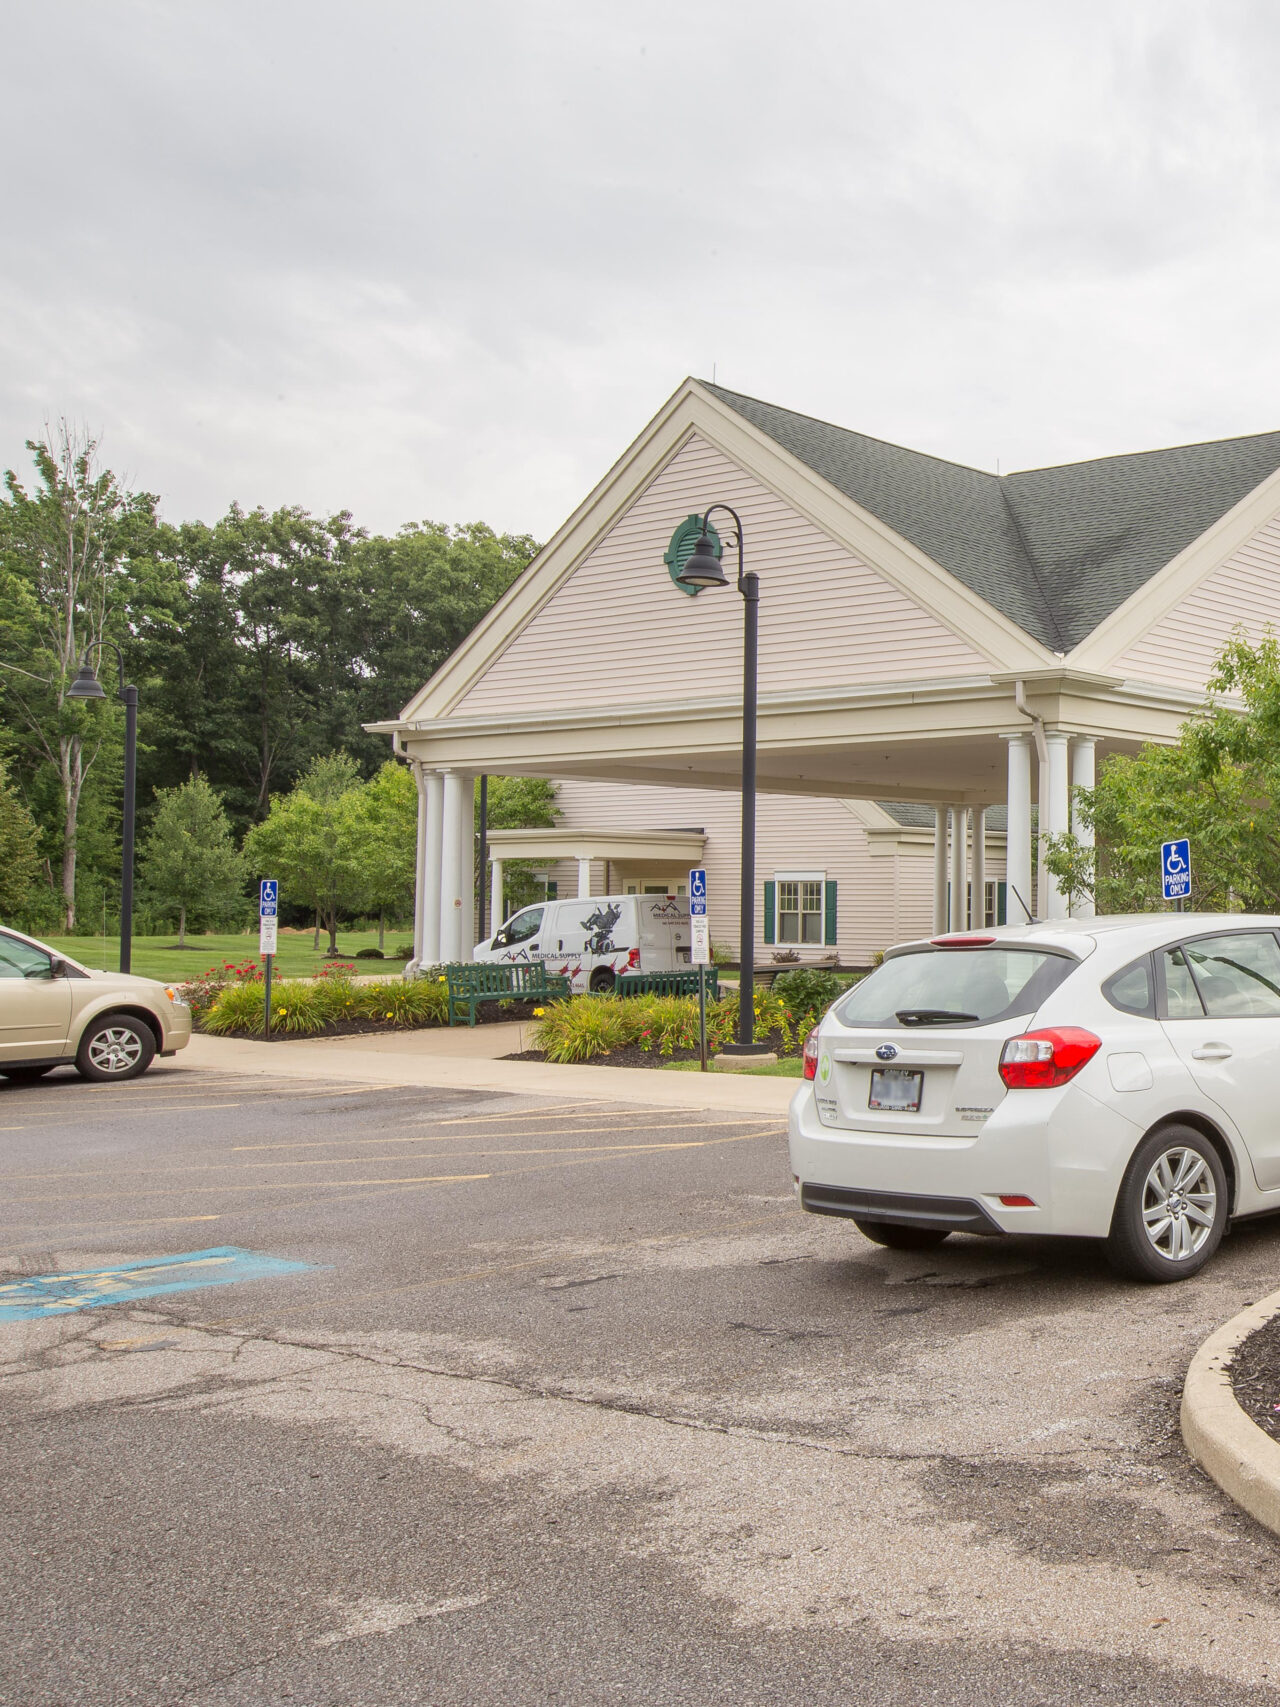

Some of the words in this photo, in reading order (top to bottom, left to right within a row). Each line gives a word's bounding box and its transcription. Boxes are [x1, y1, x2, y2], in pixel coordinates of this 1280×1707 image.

[1165, 872, 1188, 885] PARKING
[1170, 883, 1185, 895] ONLY
[531, 952, 553, 960] MEDICAL
[554, 952, 582, 960] SUPPLY
